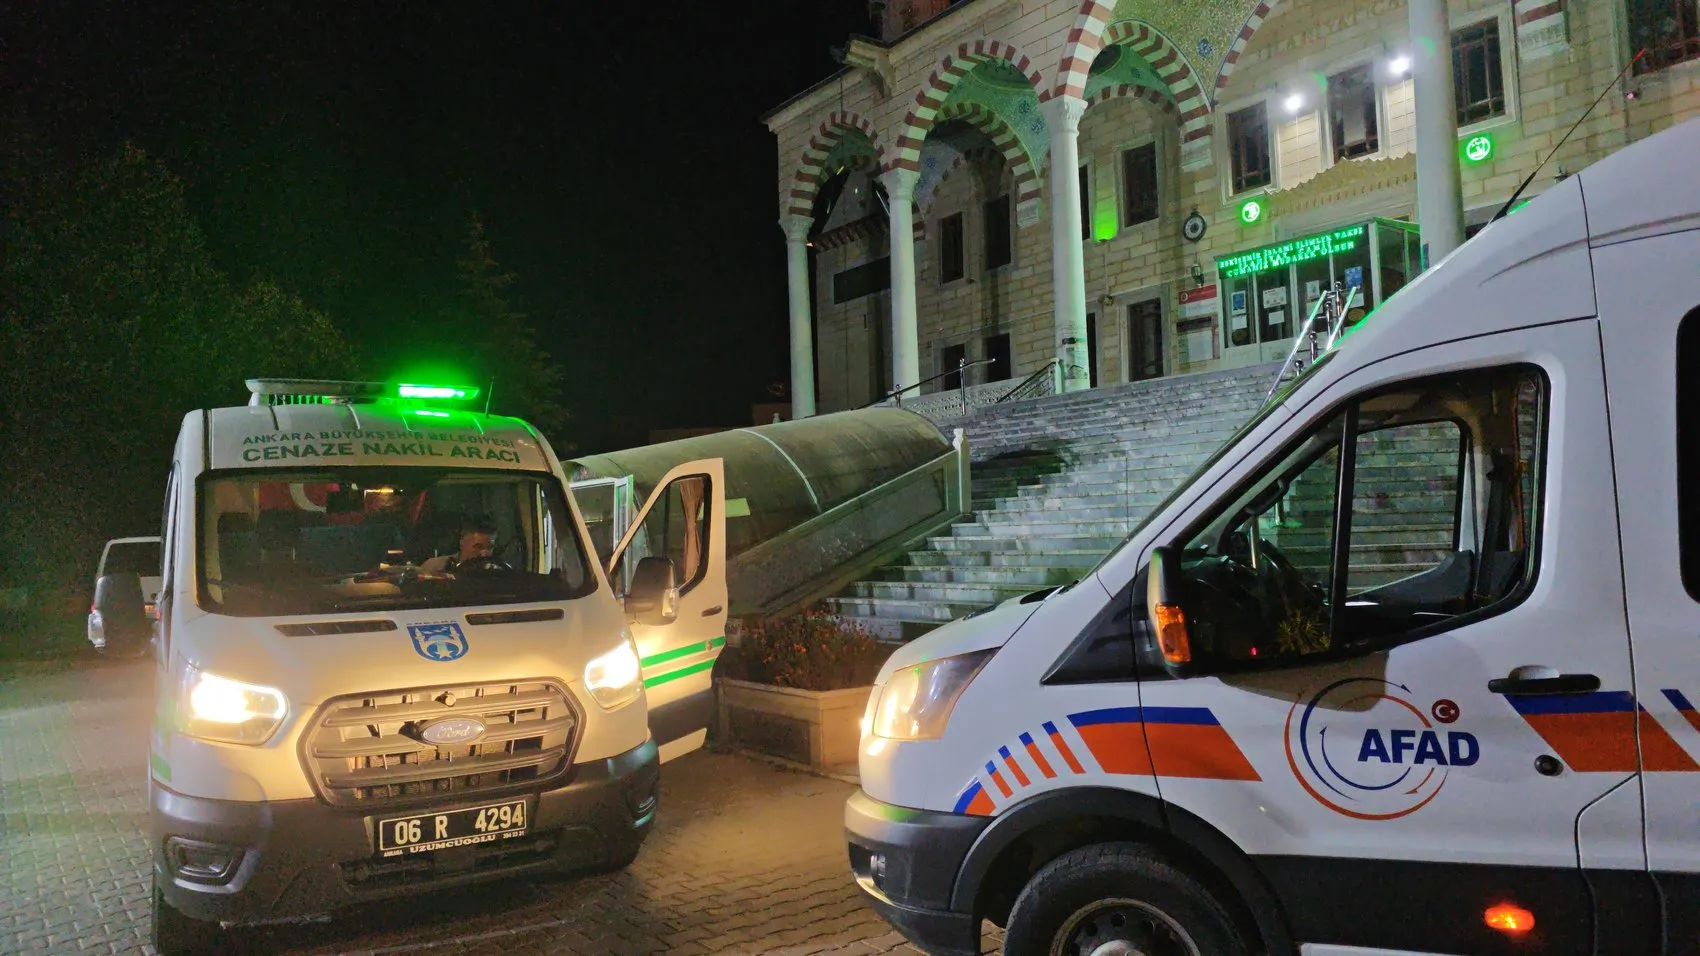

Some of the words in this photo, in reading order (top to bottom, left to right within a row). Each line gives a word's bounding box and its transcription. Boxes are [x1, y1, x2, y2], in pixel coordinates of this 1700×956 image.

[243, 432, 315, 445] ANKARA
[242, 442, 354, 462] CENAZE
[362, 441, 443, 456] NAKİL
[450, 444, 521, 463] ARACI
[437, 723, 470, 738] Ford
[1357, 728, 1480, 767] AFAD
[394, 819, 421, 845] 06
[435, 815, 448, 839] R
[475, 803, 523, 832] 4294
